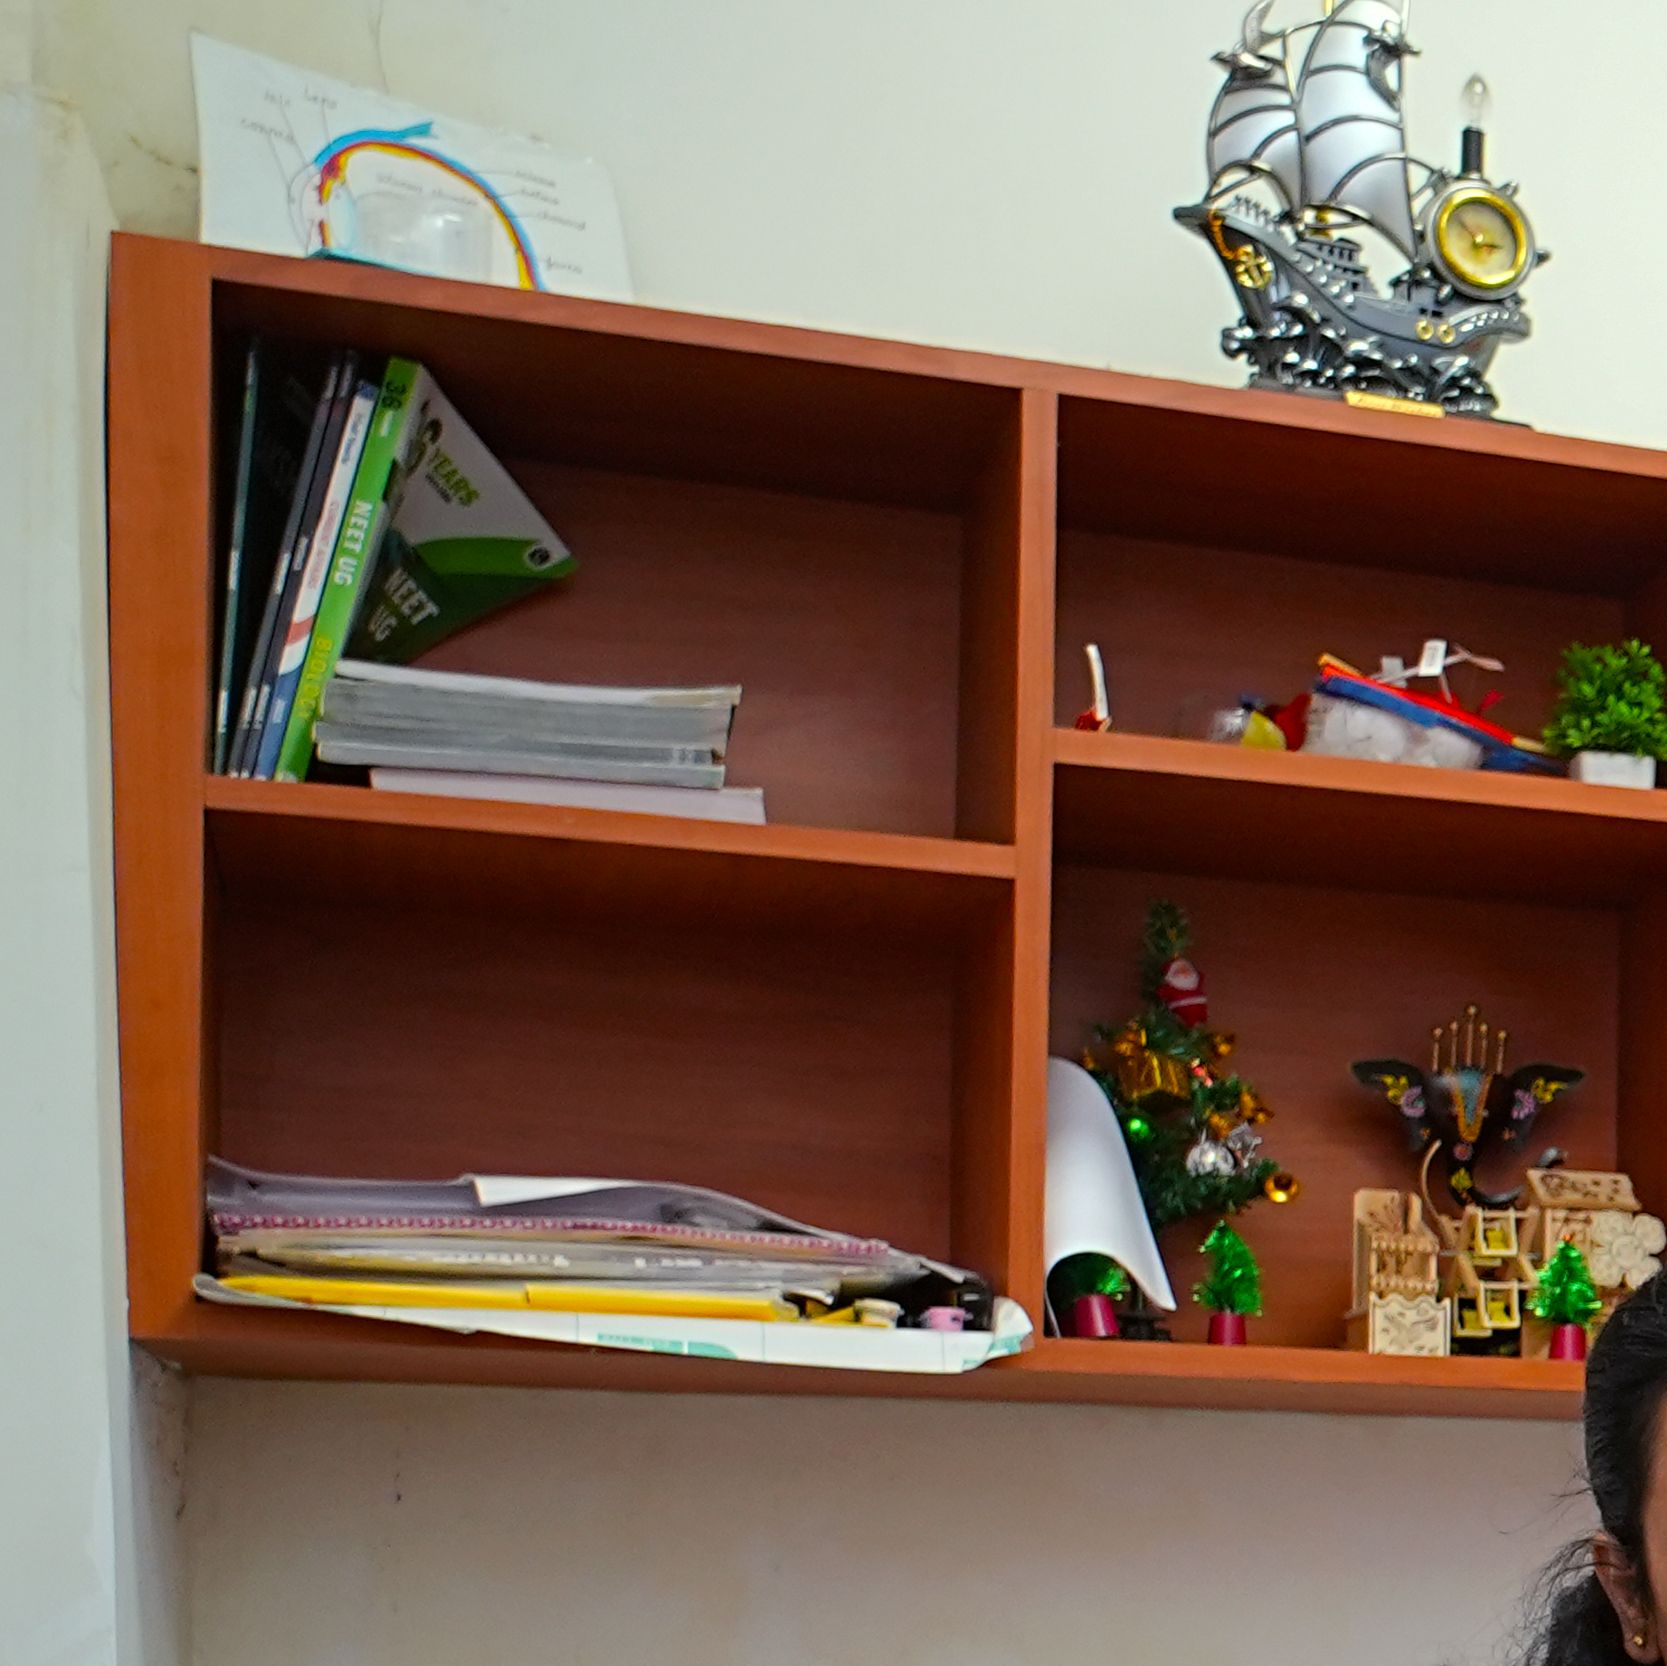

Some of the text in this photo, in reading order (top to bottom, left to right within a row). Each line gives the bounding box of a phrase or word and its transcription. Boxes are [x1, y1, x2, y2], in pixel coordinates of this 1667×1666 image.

[346, 500, 373, 551] NEET
[335, 556, 357, 585] UG
[384, 566, 440, 626] NEET
